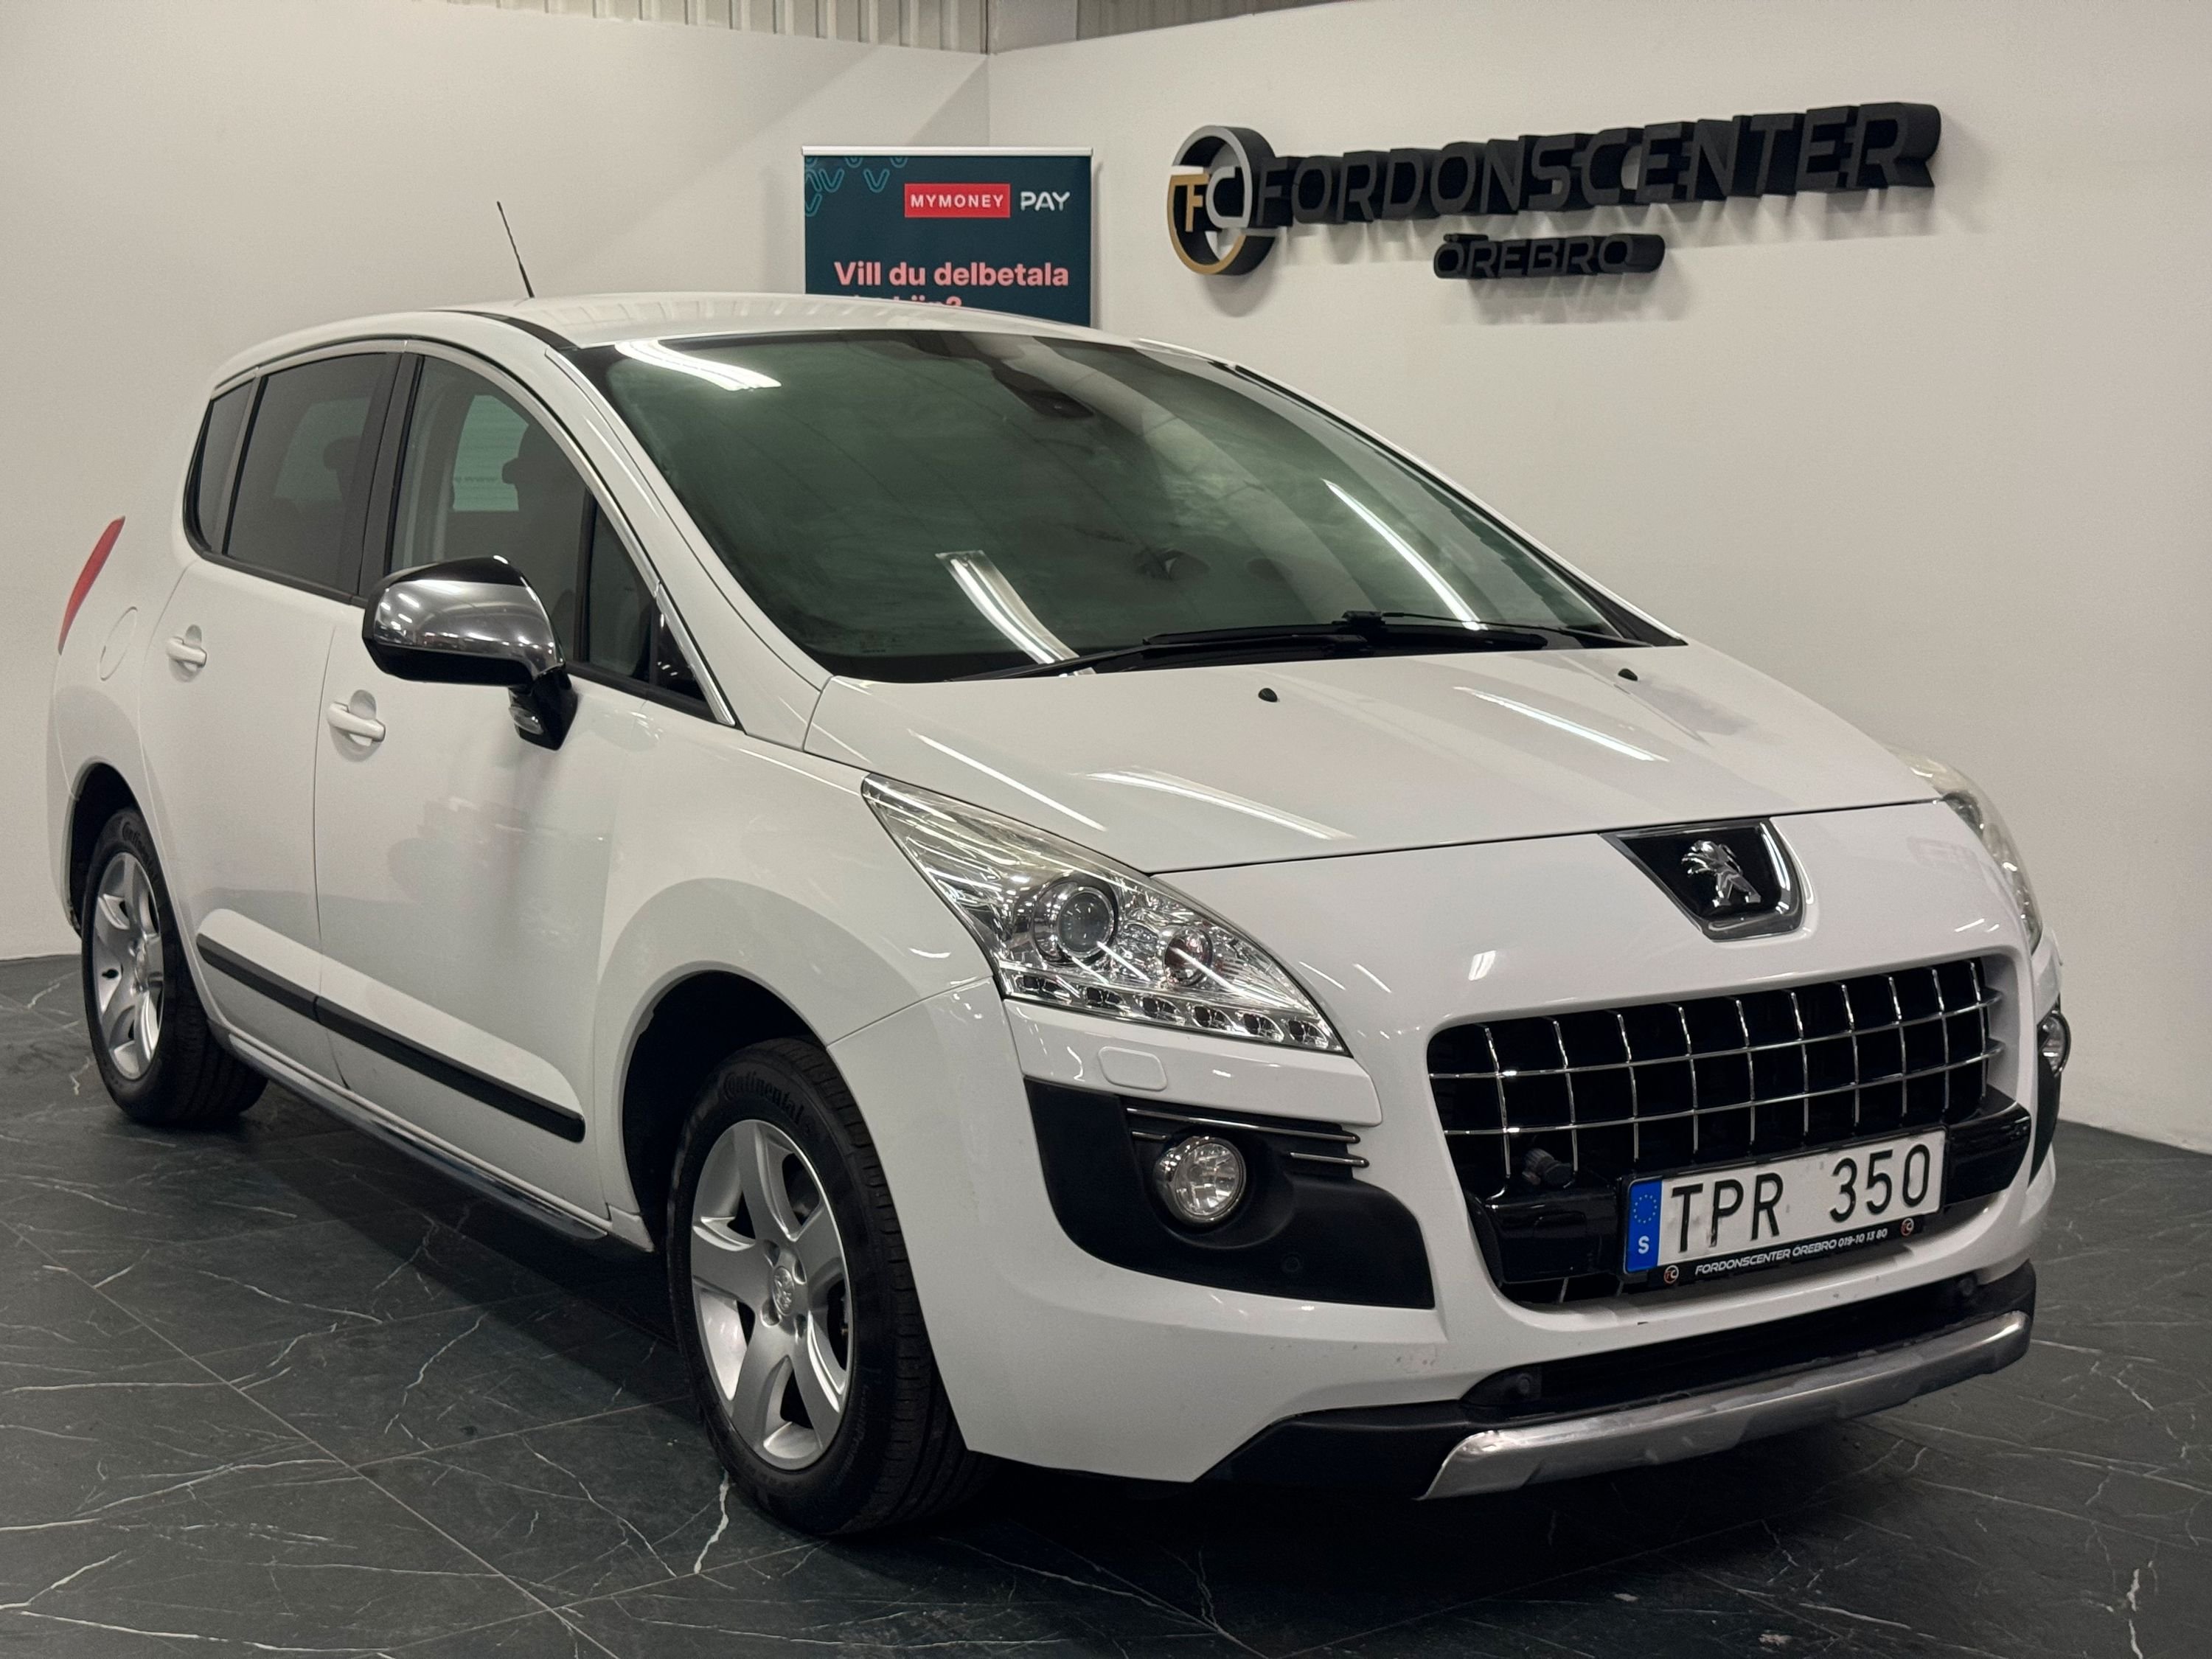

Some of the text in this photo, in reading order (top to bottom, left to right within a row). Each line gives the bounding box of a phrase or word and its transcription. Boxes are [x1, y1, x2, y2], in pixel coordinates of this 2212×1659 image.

[1256, 102, 1910, 226] FORDONSCENTER
[910, 191, 1071, 211] MYMONEY PAY
[834, 261, 1069, 286] Vill du delbetala
[1433, 234, 1635, 279] ÖREBRO
[1671, 1144, 1930, 1253] TPR 350
[1638, 1235, 1650, 1254] S
[1695, 1248, 1791, 1275] FORDONSCENTER
[1837, 1234, 1865, 1248] 019-10
